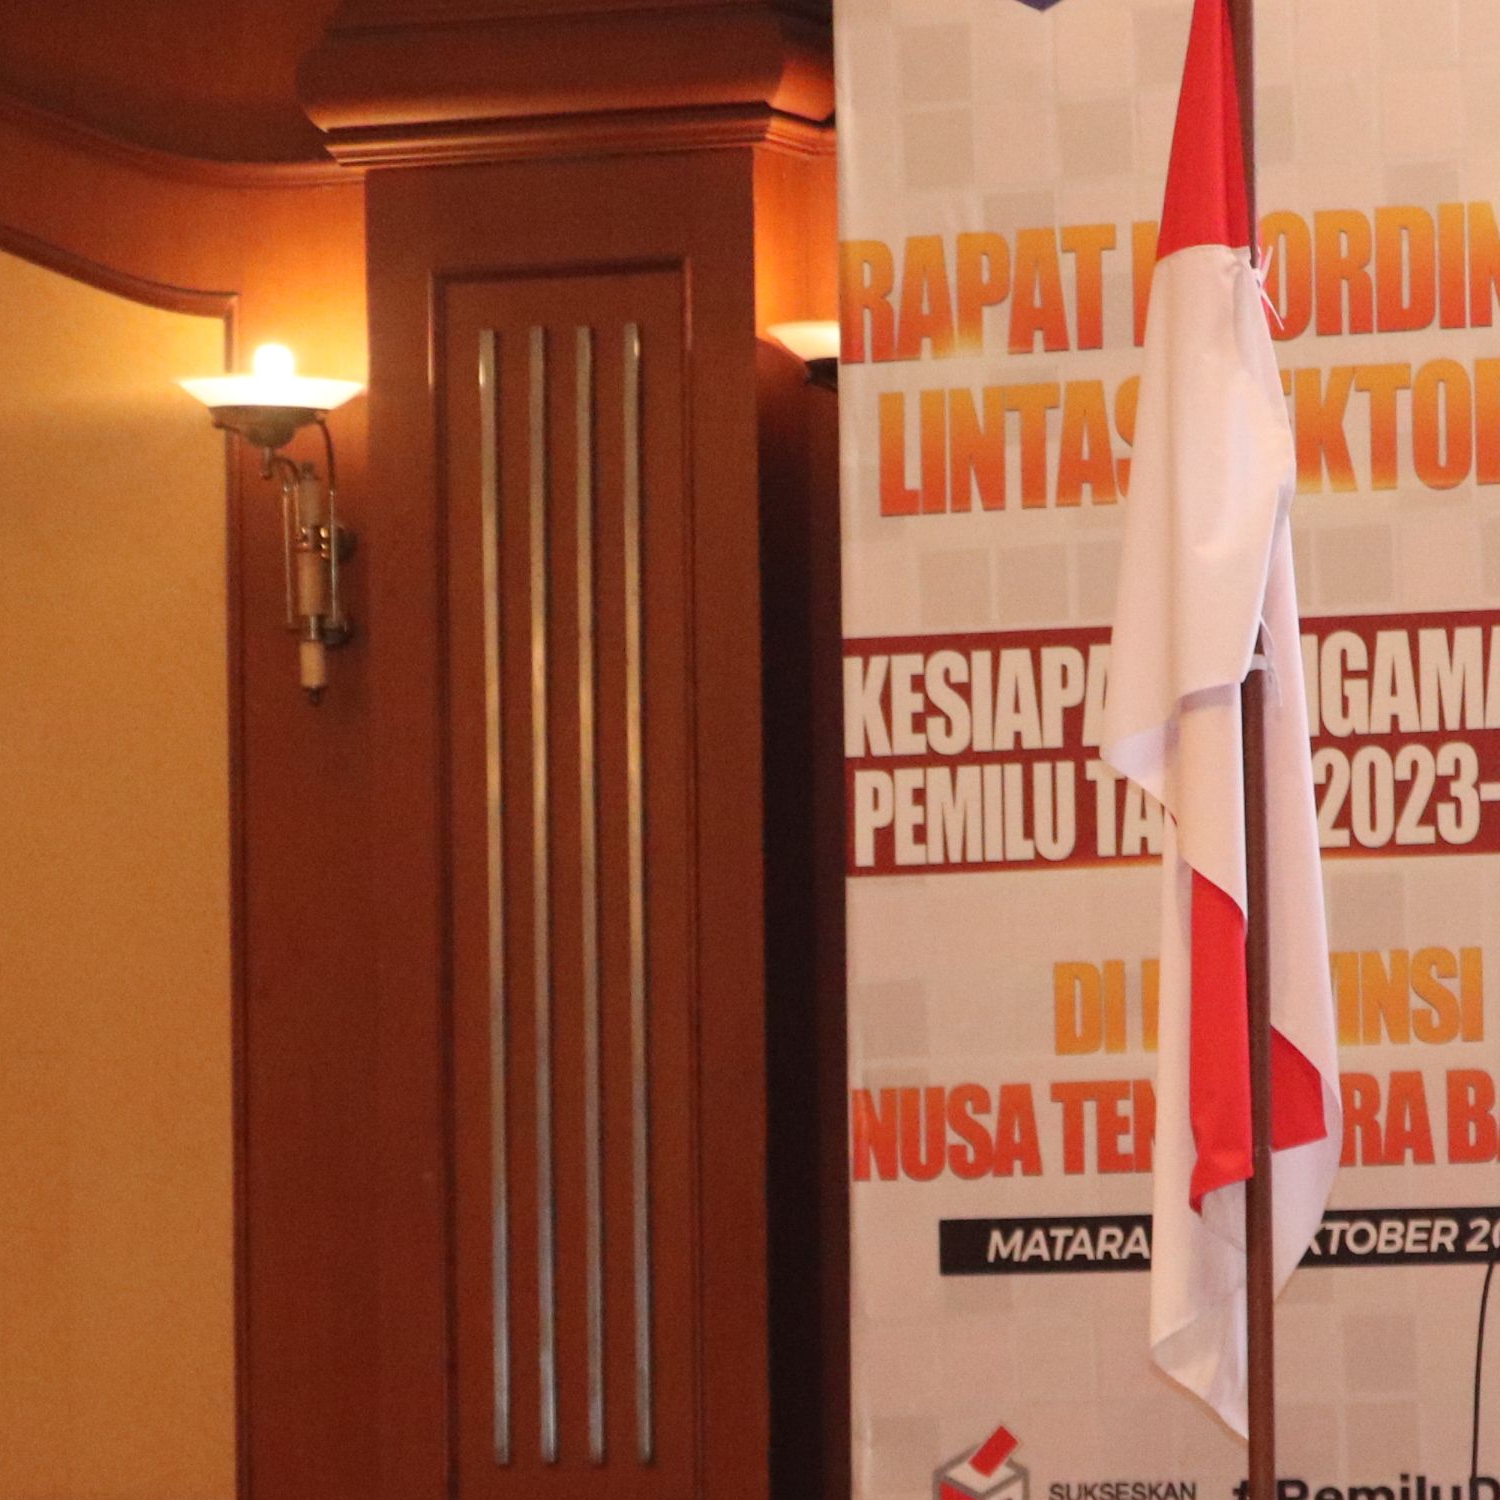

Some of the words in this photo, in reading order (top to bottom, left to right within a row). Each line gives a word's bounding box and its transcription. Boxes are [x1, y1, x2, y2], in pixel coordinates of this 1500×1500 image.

[840, 224, 1116, 365] RAPAT
[854, 758, 1077, 869] PEMILU
[1053, 959, 1127, 1056] DI
[852, 1082, 1043, 1182] NUSA
[986, 1225, 1152, 1264] MATARA
